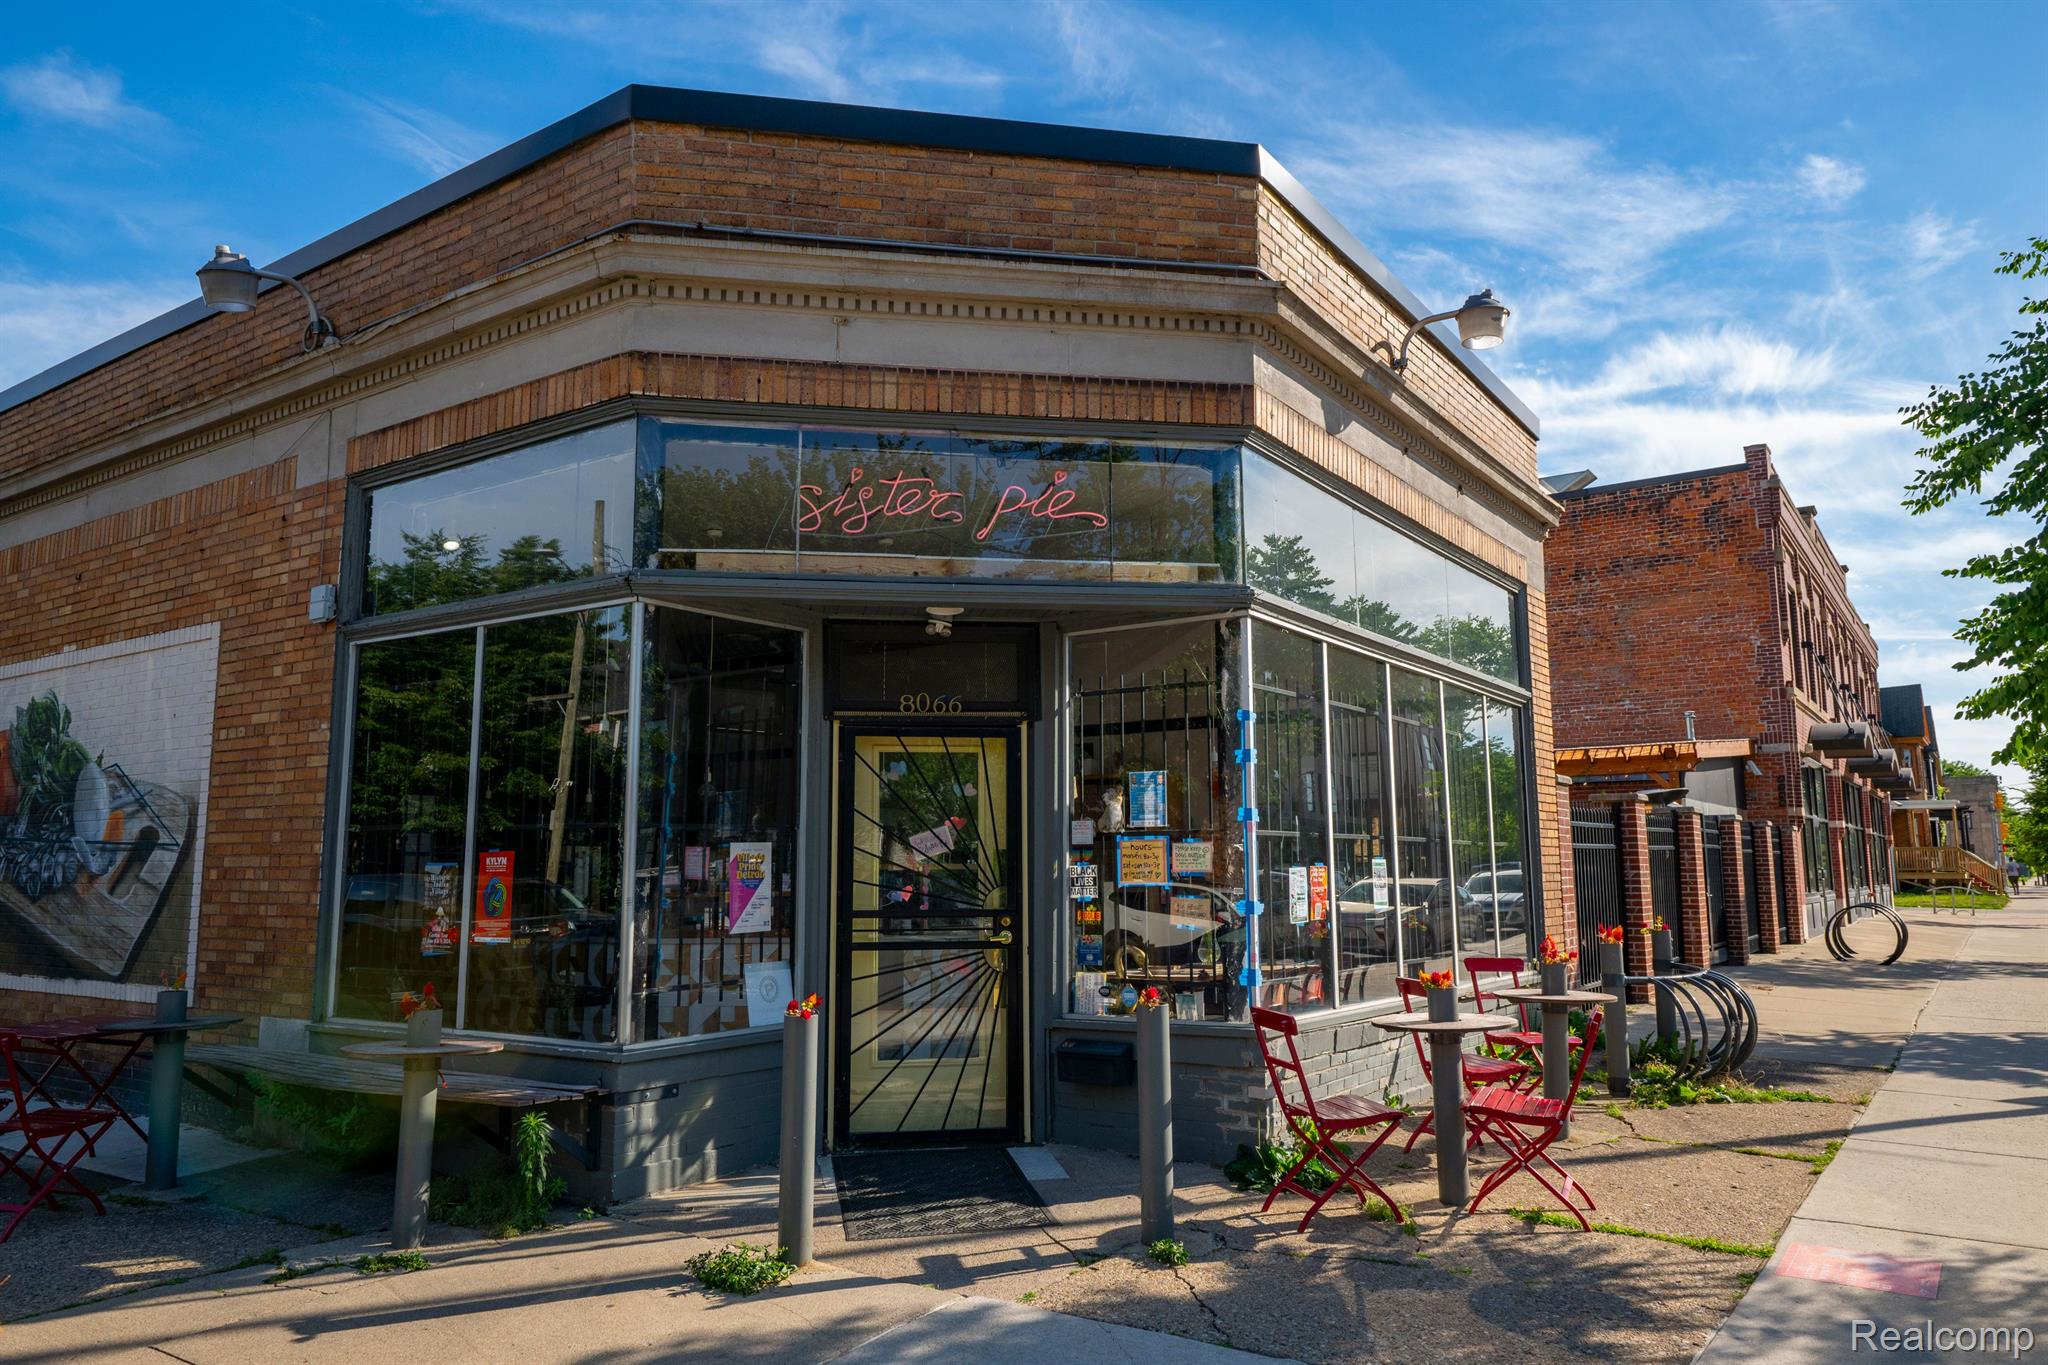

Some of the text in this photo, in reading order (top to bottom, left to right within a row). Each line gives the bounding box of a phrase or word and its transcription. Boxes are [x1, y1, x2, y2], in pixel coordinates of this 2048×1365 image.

[799, 467, 1108, 541] sister pie
[899, 692, 963, 713] 8066
[485, 856, 508, 866] KYLYN
[737, 862, 761, 871] Pride
[1070, 866, 1097, 876] BLACK
[735, 870, 766, 880] Detroit
[1073, 876, 1094, 886] LIVES
[1070, 887, 1099, 896] MATTER
